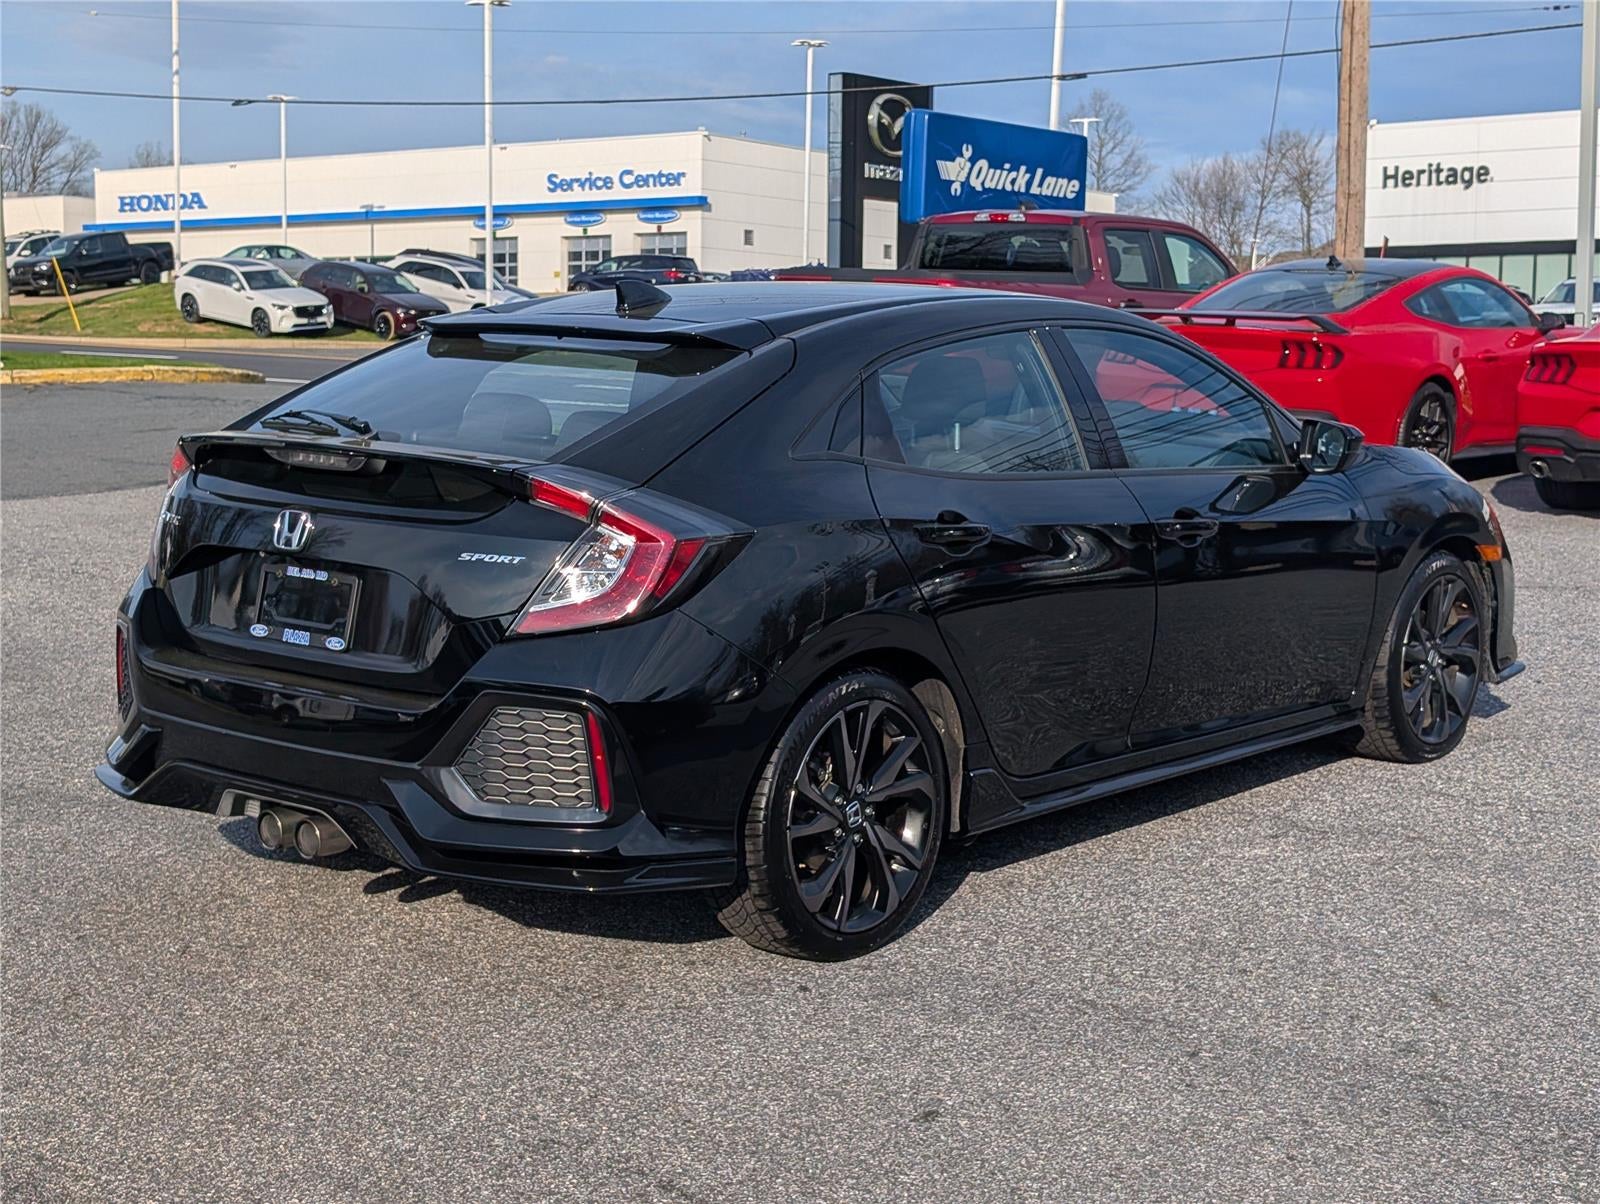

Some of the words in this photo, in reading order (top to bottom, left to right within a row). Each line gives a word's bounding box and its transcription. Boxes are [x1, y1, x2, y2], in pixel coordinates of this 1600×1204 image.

[547, 171, 614, 192] Service
[619, 169, 686, 189] Center
[969, 159, 1031, 192] Quick
[1029, 168, 1080, 199] Lane
[118, 192, 208, 213] HONDA
[457, 552, 526, 564] SPORT
[283, 628, 311, 646] PLAZA
